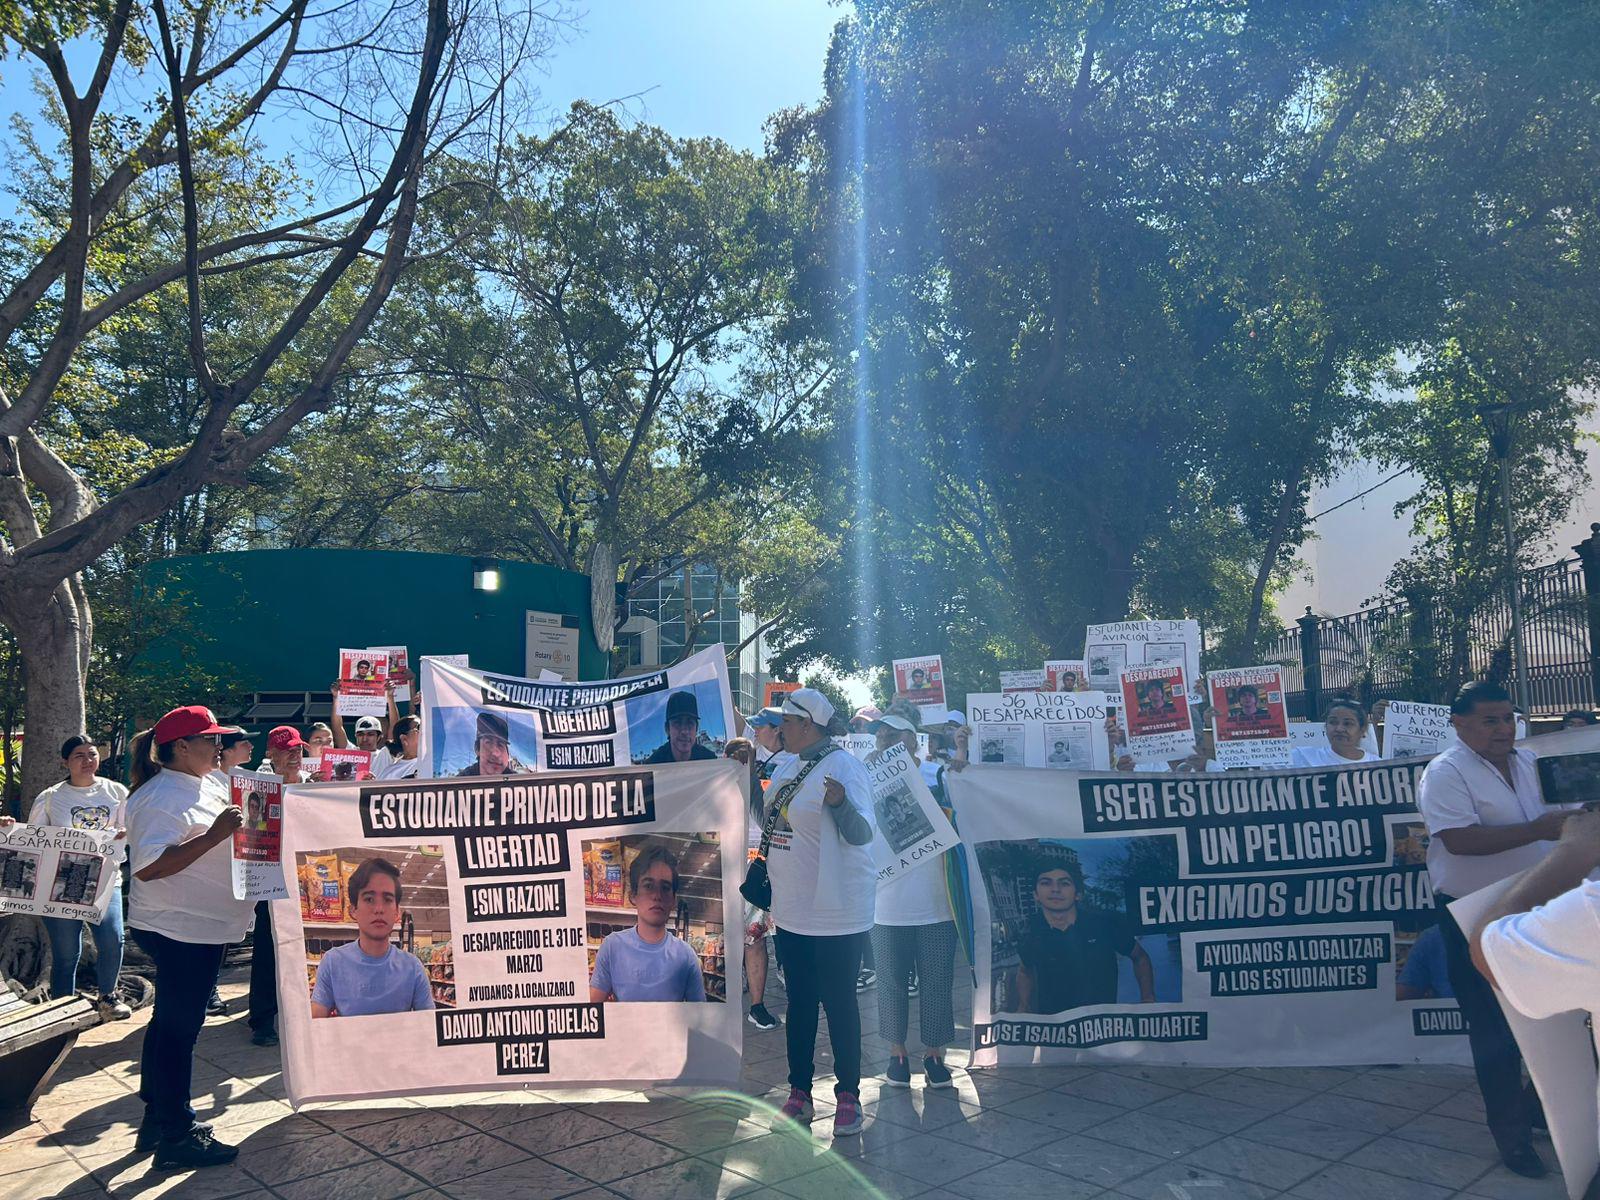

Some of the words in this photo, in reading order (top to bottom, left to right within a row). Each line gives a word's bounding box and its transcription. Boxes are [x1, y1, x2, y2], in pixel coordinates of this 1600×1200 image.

[1088, 623, 1161, 635] ESTUDIANTES
[1170, 621, 1185, 631] DE
[1102, 633, 1149, 642] AVIACIÓN
[535, 651, 552, 660] Rotary
[1125, 668, 1178, 683] DESAPARECIDO
[1215, 674, 1276, 688] DESAPARECIDO
[487, 680, 569, 707] ESTUDIANTE
[572, 684, 628, 707] PRIVADO
[1002, 694, 1025, 708] 56
[546, 705, 610, 734] LIBERTAD
[973, 705, 1105, 722] DESAPARECIDOS
[1390, 701, 1451, 719] QUEREMOS
[1409, 717, 1416, 725] A
[1394, 724, 1402, 732] Y
[1408, 727, 1447, 739] SALVOS
[325, 753, 368, 763] DESAPARECIDO
[551, 747, 572, 766] !SIN
[574, 743, 610, 765] RAZON!
[233, 777, 277, 794] DESAPARECIDO
[369, 788, 495, 829] ESTUDIANTE
[501, 783, 587, 825] PRIVADO
[592, 781, 618, 818] DE
[621, 779, 646, 816] LA
[1093, 782, 1156, 822] !SER
[1161, 774, 1329, 818] ESTUDIANTE
[25, 825, 46, 838] 56
[1200, 826, 1238, 865] UN
[1244, 818, 1372, 862] PELIGRO!
[464, 833, 560, 869] LIBERTAD
[900, 859, 909, 869] A
[472, 888, 503, 916] !SIN
[507, 884, 559, 913] RAZON!
[1140, 881, 1287, 925] EXIGIMOS
[1295, 870, 1435, 916] JUSTICIA
[61, 906, 102, 923] regreso!
[463, 929, 540, 952] DESAPARECIDO
[543, 929, 554, 948] EL
[556, 928, 568, 947] 31
[570, 928, 583, 946] DE
[1203, 939, 1284, 966] AYUDANOS
[1287, 940, 1298, 961] A
[1301, 937, 1384, 961] LOCALIZAR
[506, 954, 543, 974] MARZO
[1218, 973, 1227, 992] A
[1231, 970, 1260, 991] LOS
[1263, 965, 1367, 990] ESTUDIANTES
[469, 984, 513, 1001] AYUDANOS
[515, 983, 520, 999] A
[521, 981, 574, 998] LOCALIZARLO
[442, 1013, 483, 1040] DAVID
[486, 1009, 544, 1037] ANTONIO
[547, 1007, 599, 1034] RUELAS
[981, 1023, 1020, 1045] JOSE
[1025, 1023, 1077, 1044] ISAIAS
[1080, 1015, 1134, 1044] IBARRA
[1139, 1015, 1200, 1038] DUARTE
[1420, 1011, 1462, 1030] DAVID
[502, 1042, 544, 1069] PEREZ
